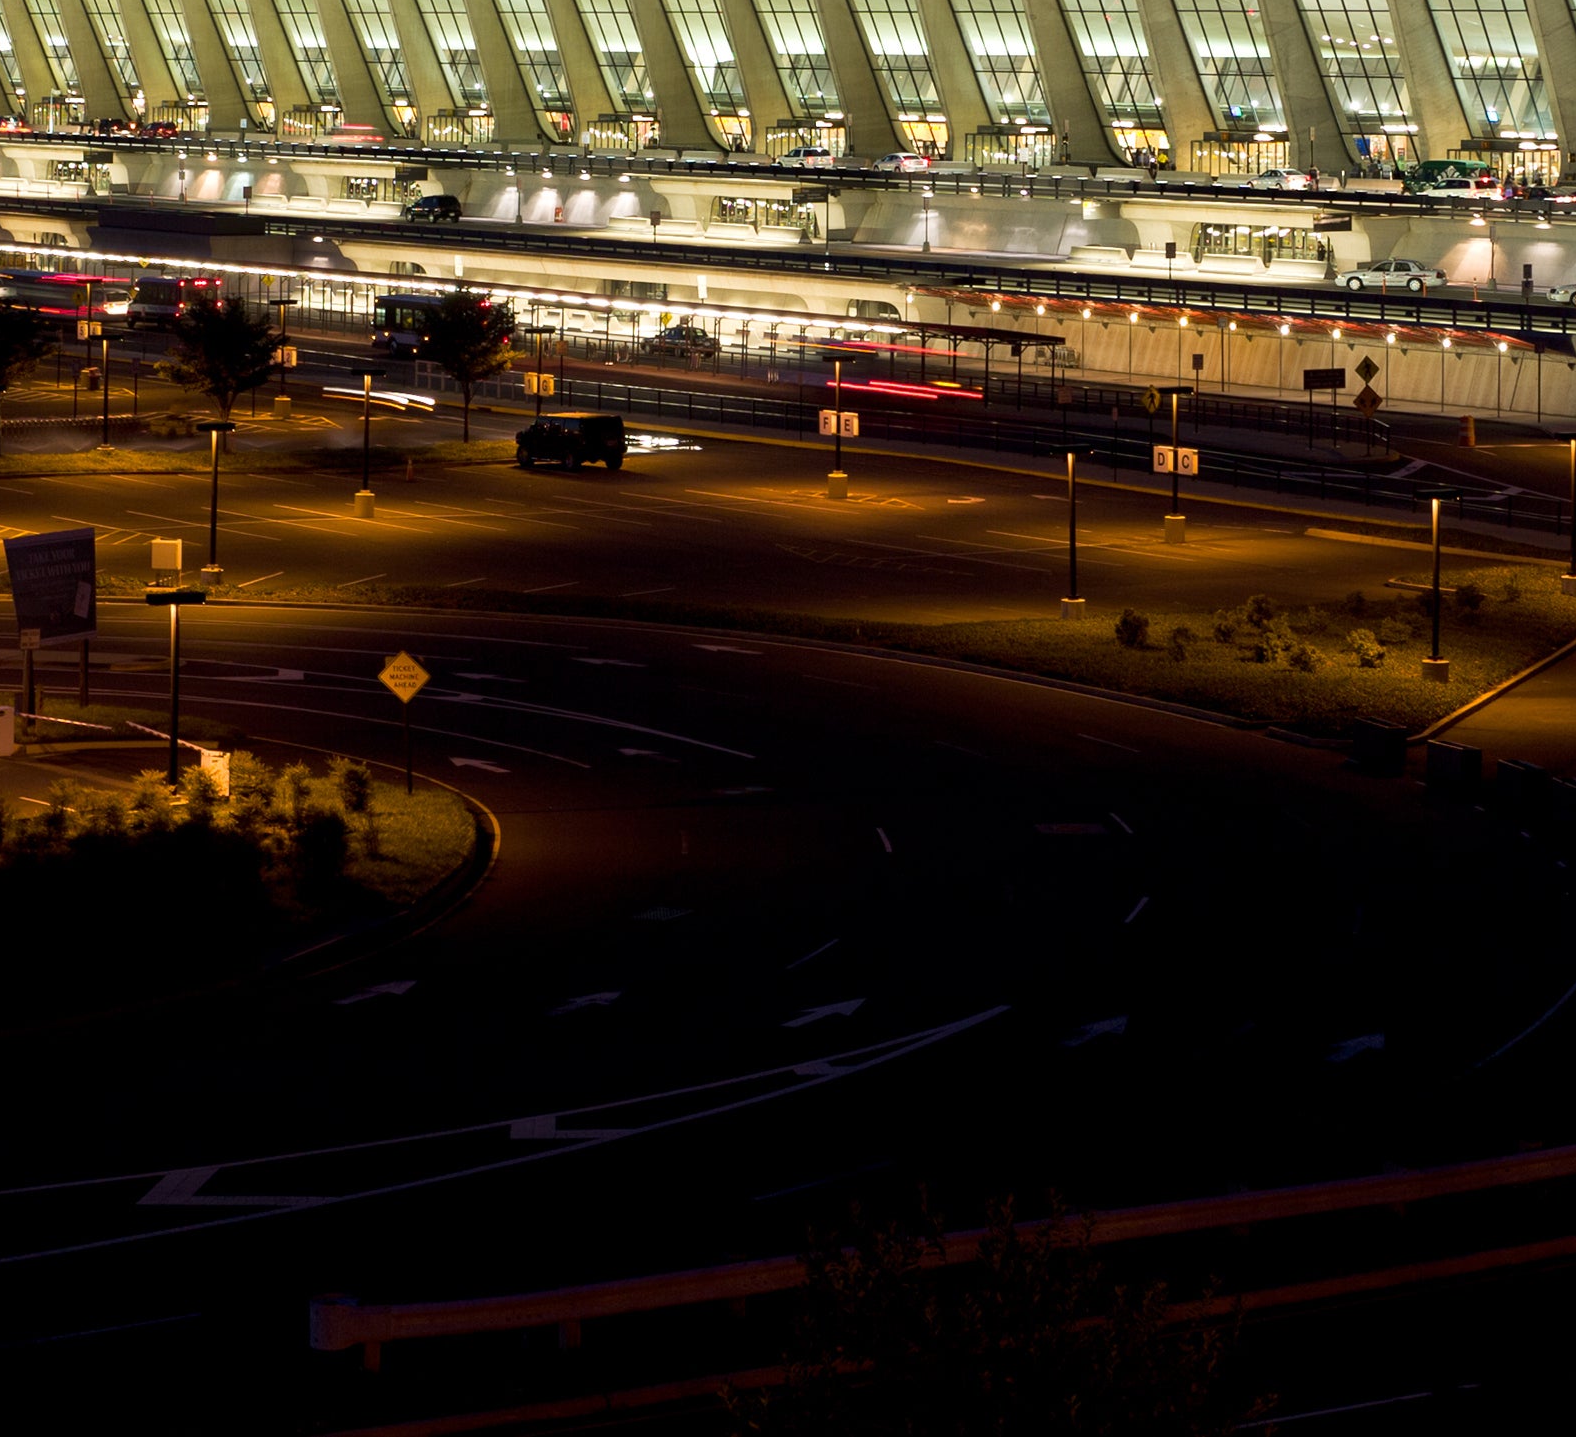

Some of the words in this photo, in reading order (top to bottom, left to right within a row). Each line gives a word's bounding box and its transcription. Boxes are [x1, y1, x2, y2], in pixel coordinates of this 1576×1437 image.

[823, 417, 829, 430] F
[844, 419, 850, 432] E
[1157, 452, 1165, 466] D
[1181, 454, 1190, 469] C
[393, 665, 415, 673] TICKET
[389, 673, 419, 681] MACHINE
[394, 681, 416, 689] AHEAD
